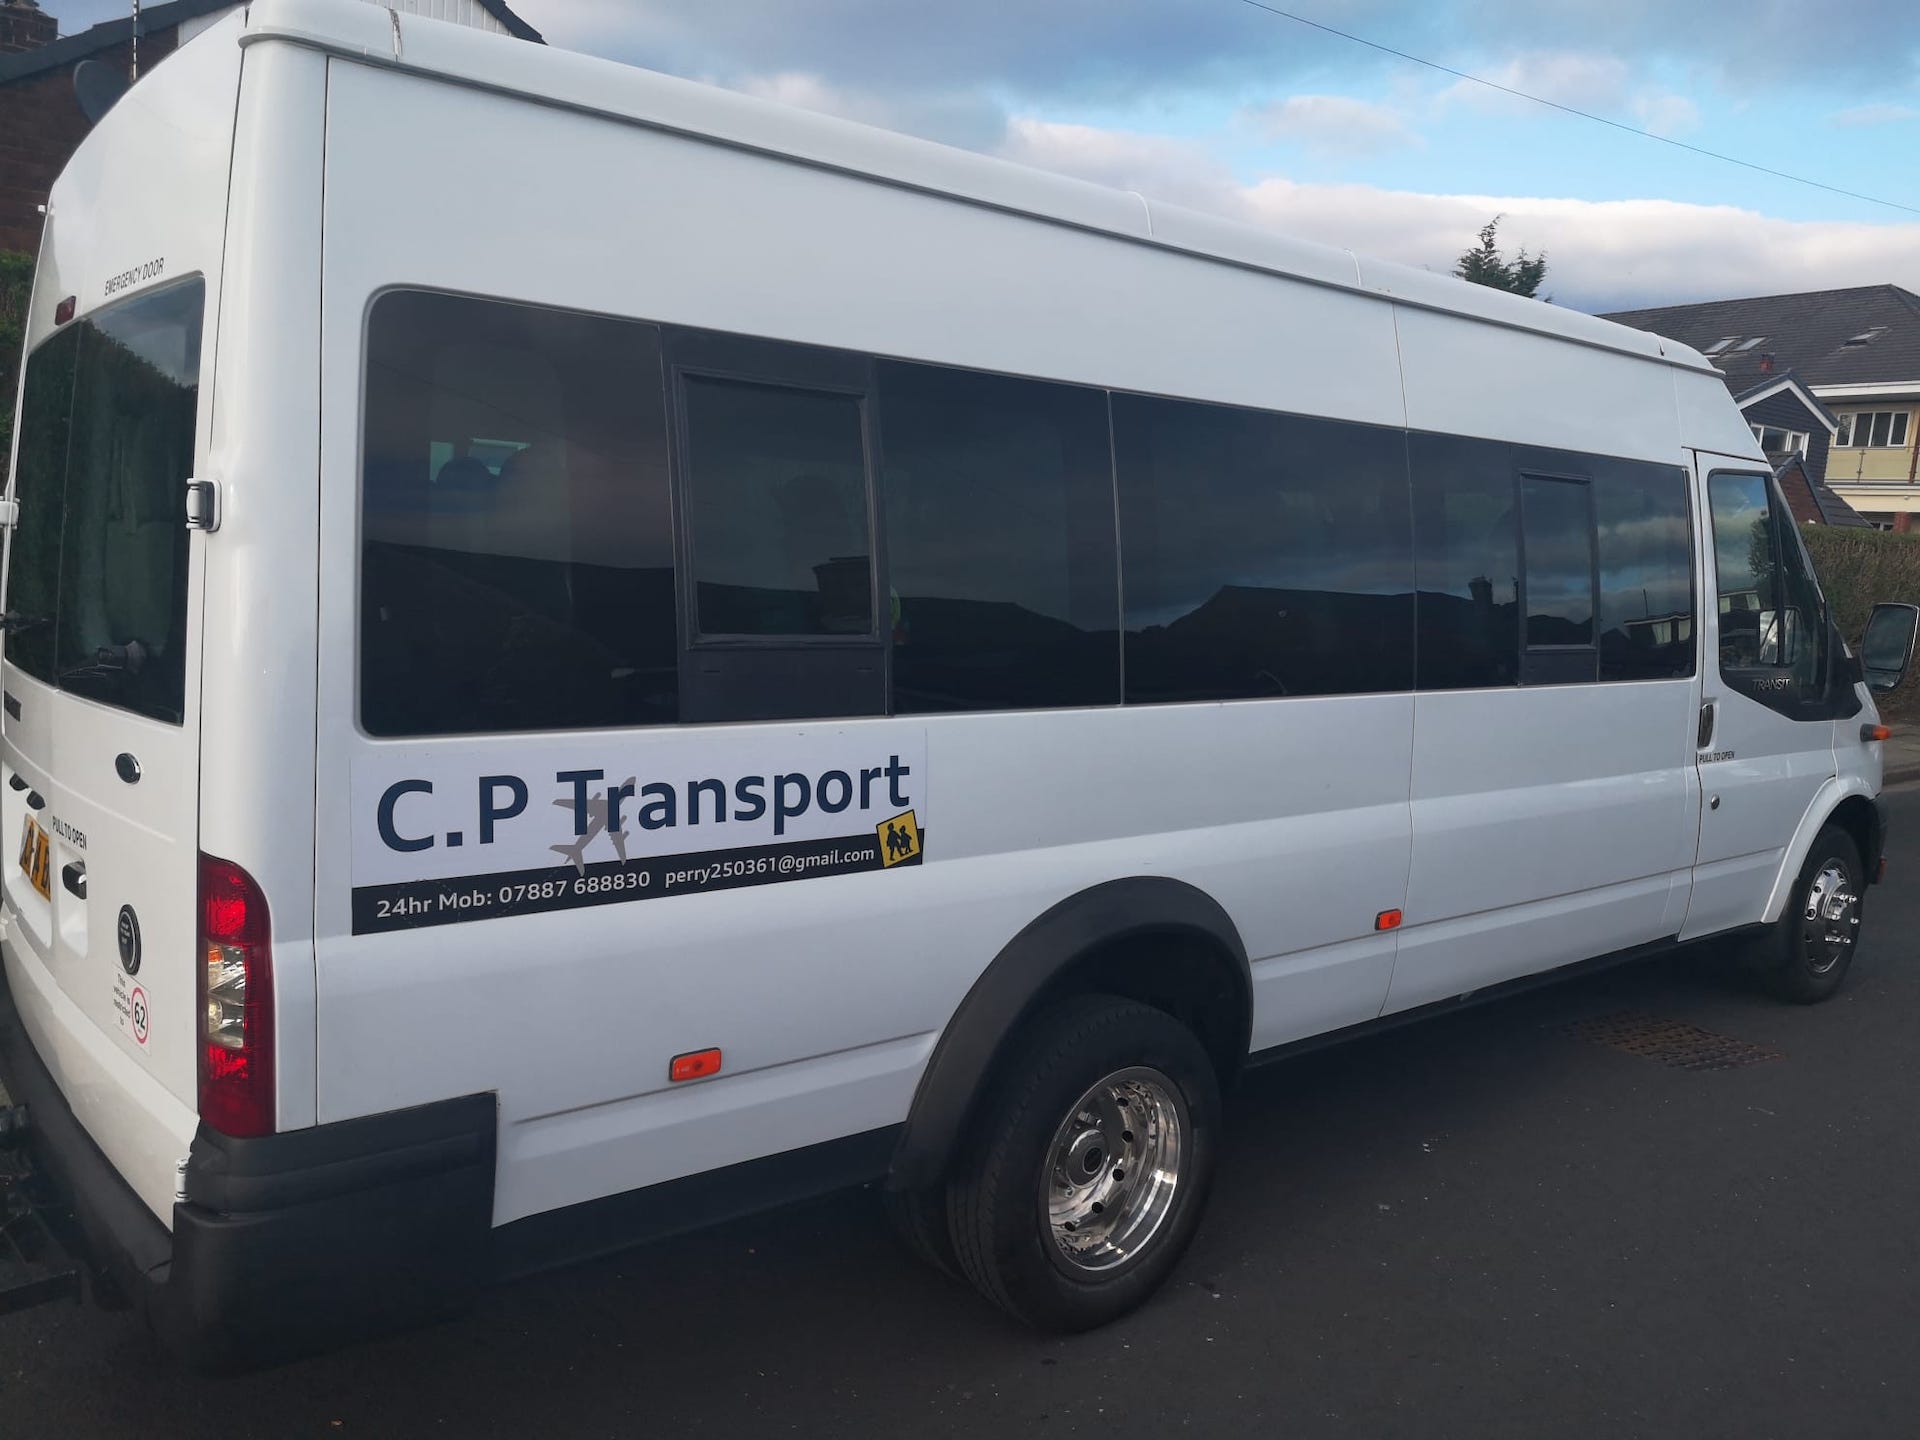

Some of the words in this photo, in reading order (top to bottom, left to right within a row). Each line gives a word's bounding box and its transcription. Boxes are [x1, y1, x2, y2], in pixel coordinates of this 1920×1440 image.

[104, 267, 143, 296] EMERGENCY
[142, 257, 165, 280] DOOR
[1751, 677, 1791, 691] TRANSIT
[1698, 753, 1713, 764] PULL
[1713, 751, 1721, 762] TO
[1721, 750, 1735, 761] OPEN
[376, 774, 530, 853] C.P
[556, 754, 911, 836] Transport
[52, 815, 65, 837] PULL
[64, 822, 72, 841] TO
[72, 828, 88, 850] OPEN
[665, 849, 875, 887] perry250361@gmail.com
[376, 897, 433, 918] 24hr
[438, 889, 493, 911] Mob:
[498, 880, 567, 903] 07887
[573, 871, 651, 895] 688830
[134, 1001, 146, 1031] 62
